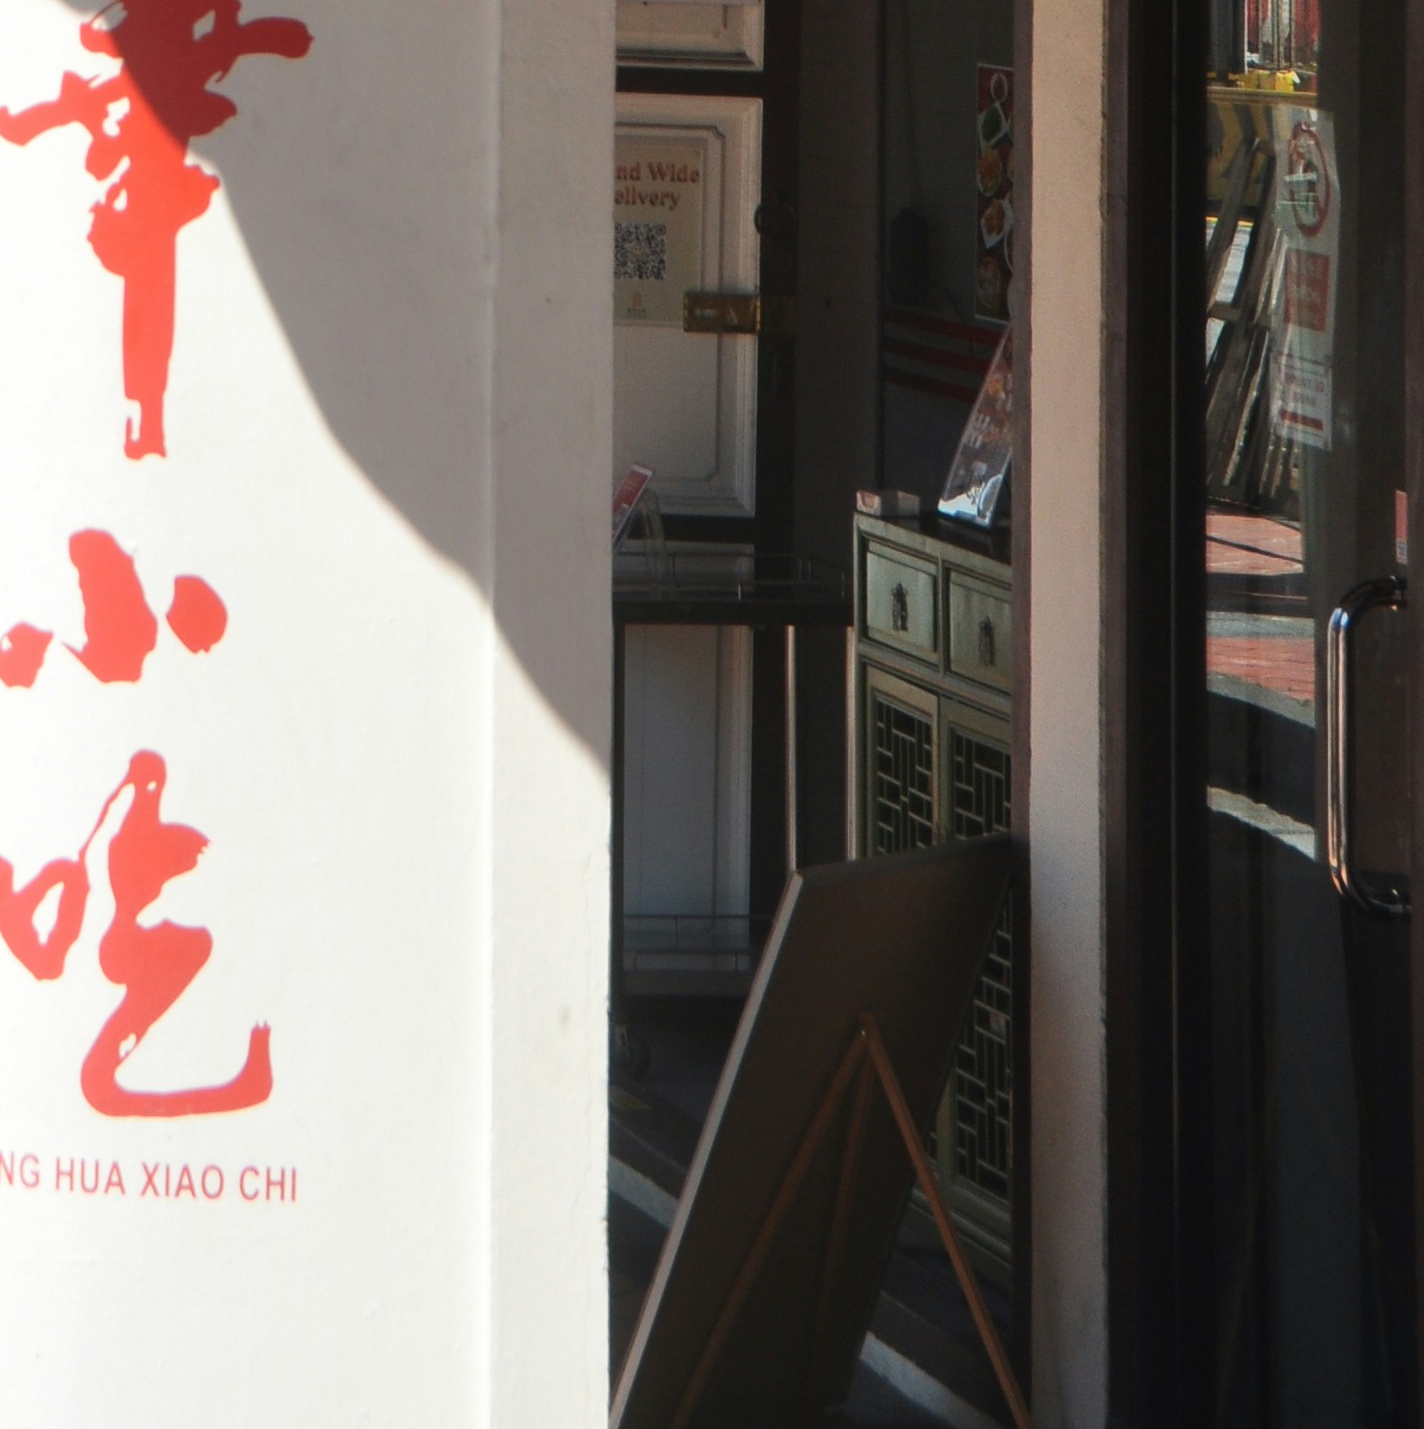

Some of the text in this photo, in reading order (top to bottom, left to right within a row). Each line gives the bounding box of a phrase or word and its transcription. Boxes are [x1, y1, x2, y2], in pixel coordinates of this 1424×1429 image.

[648, 161, 701, 183] Wide
[54, 1156, 127, 1197] HUA
[140, 1161, 226, 1201] XIAO
[238, 1165, 299, 1203] CHI
